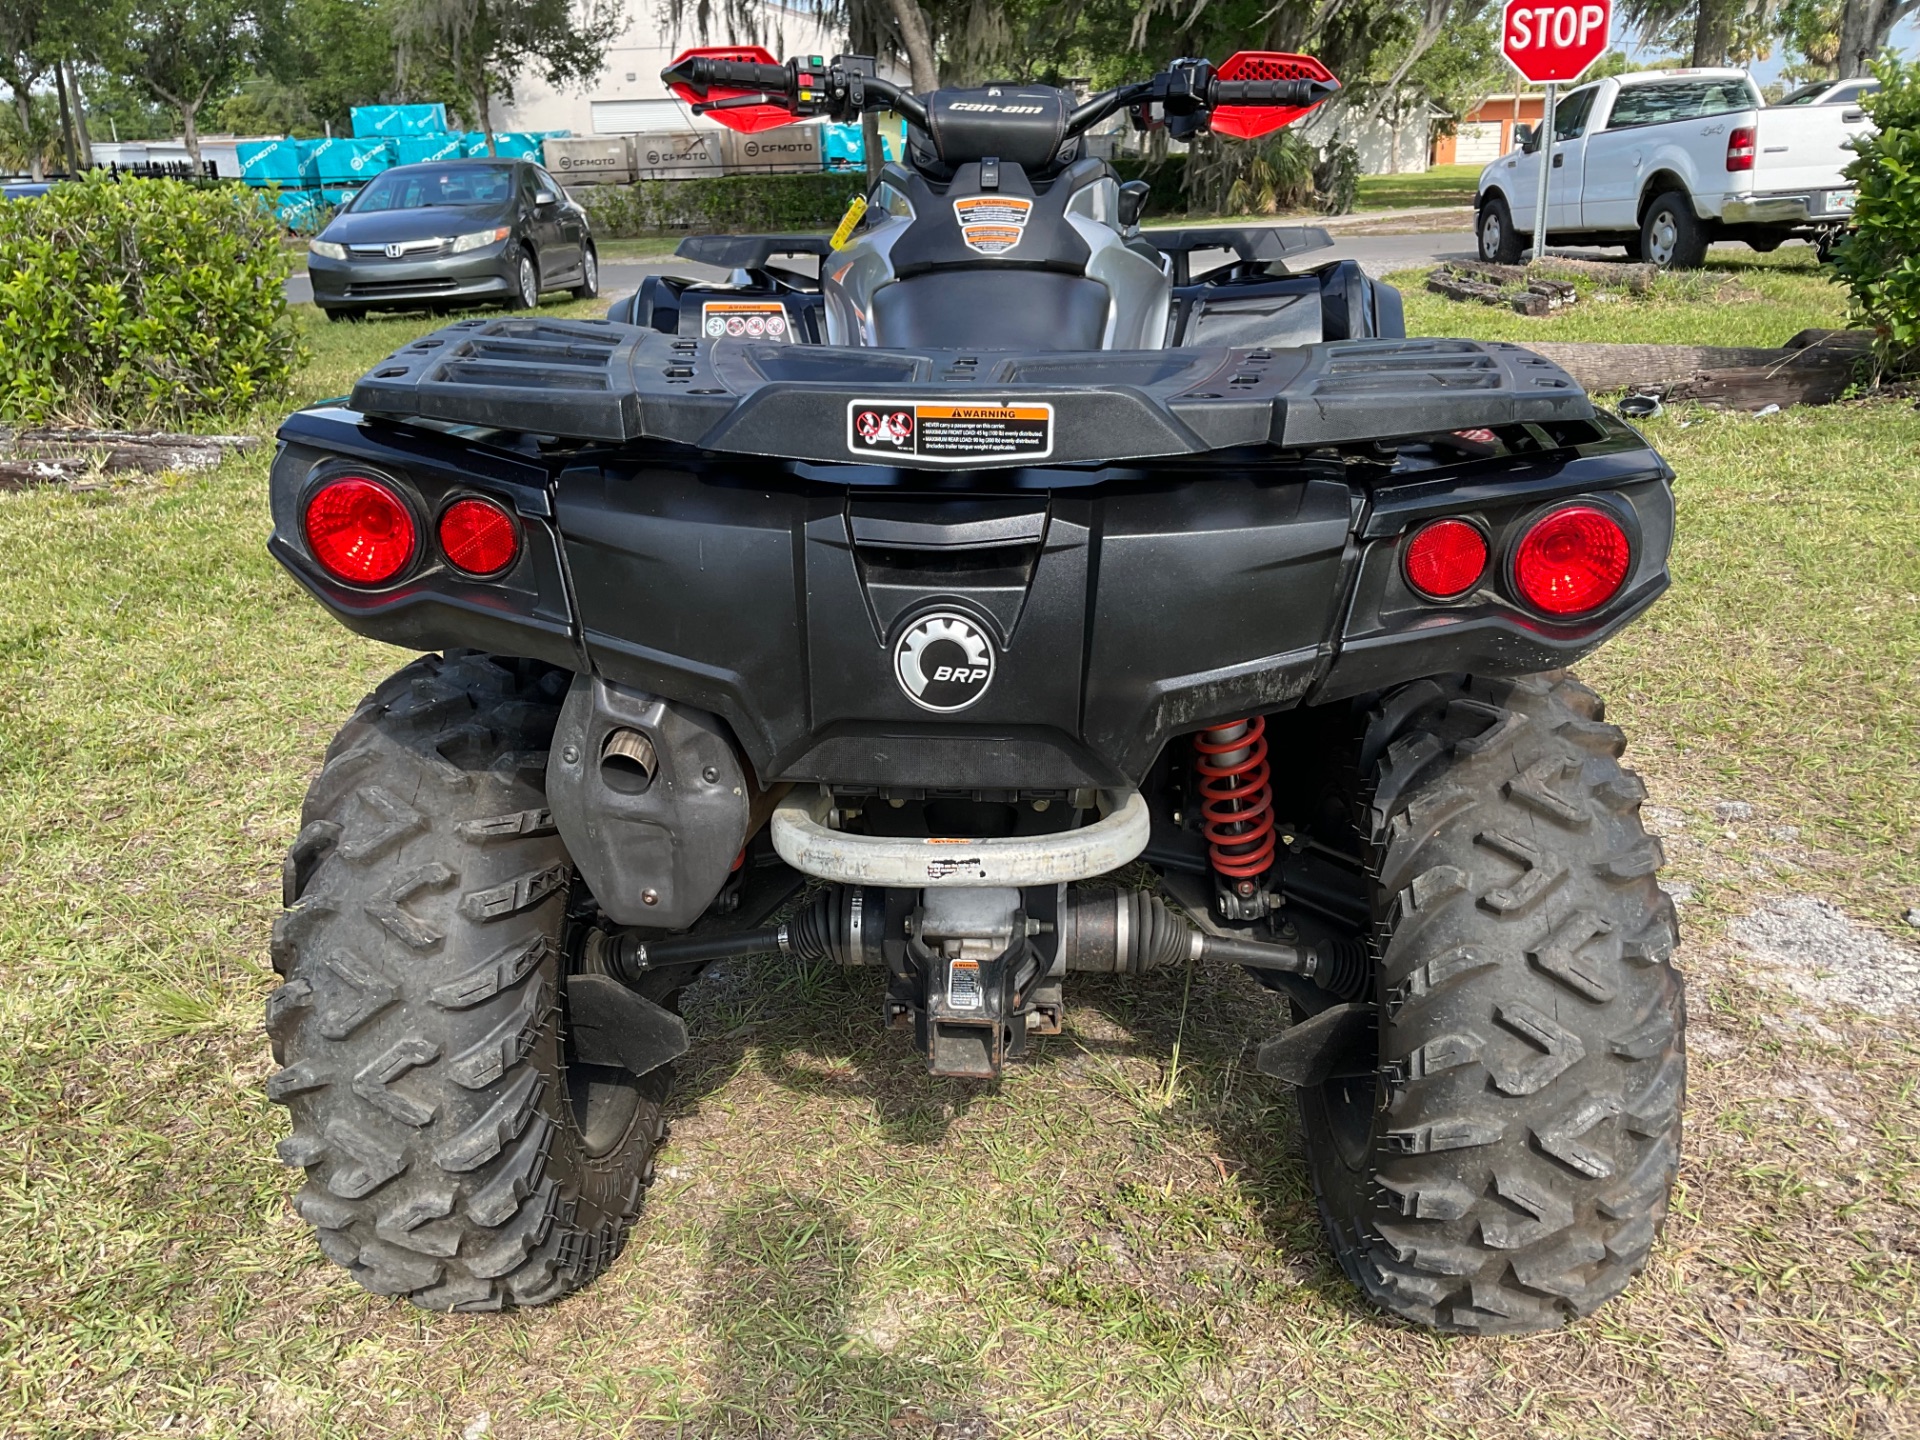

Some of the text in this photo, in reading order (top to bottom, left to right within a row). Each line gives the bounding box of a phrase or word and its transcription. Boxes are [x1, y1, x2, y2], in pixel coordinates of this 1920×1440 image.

[1509, 4, 1604, 49] STOP
[948, 102, 1044, 114] can-am
[761, 143, 812, 153] CFMOTO
[245, 143, 278, 168] CFMOTO
[572, 158, 616, 167] CFMOTO
[963, 410, 1016, 419] WARNING
[933, 666, 988, 684] BRP
